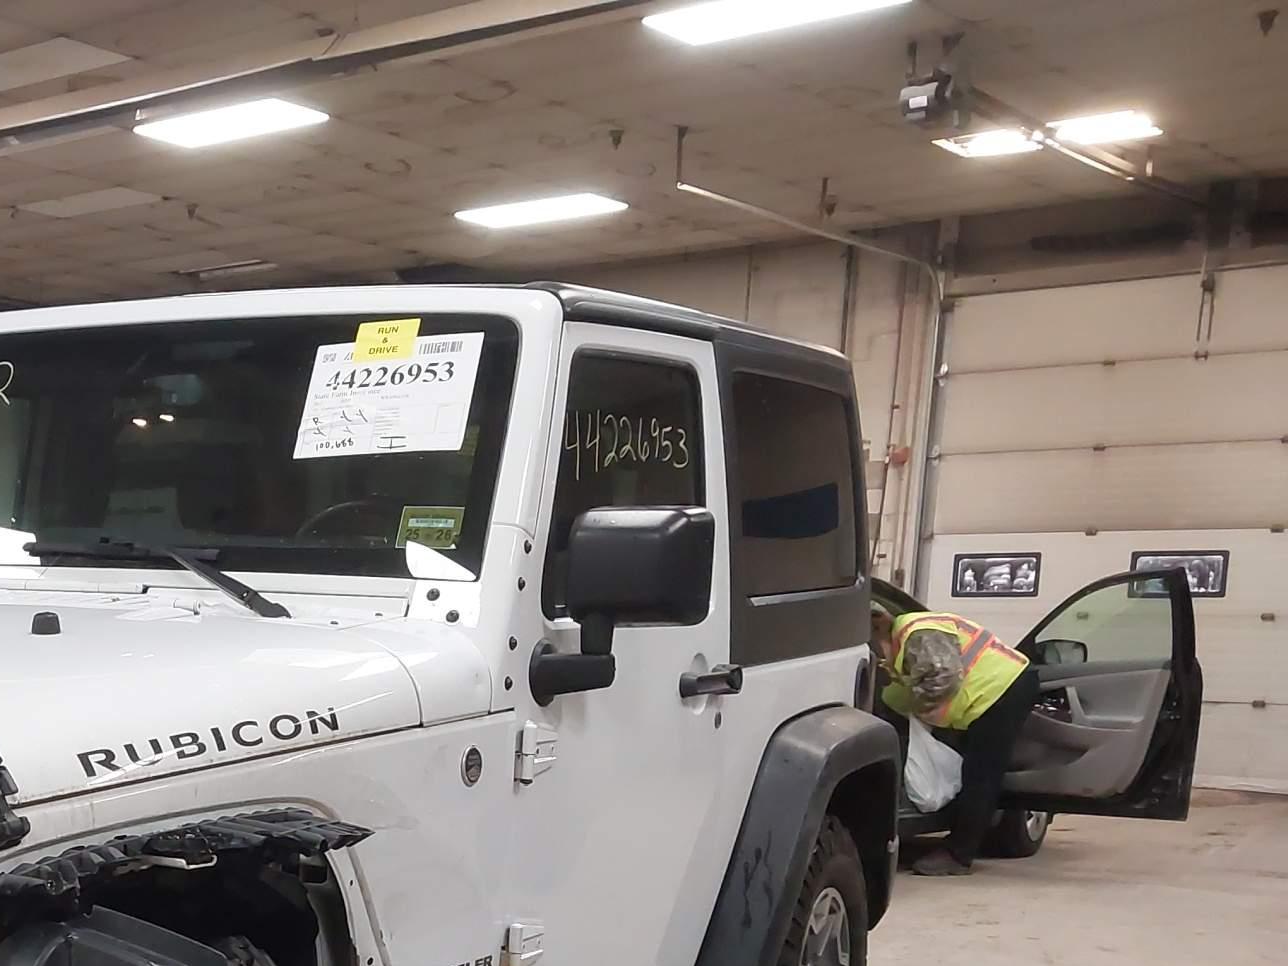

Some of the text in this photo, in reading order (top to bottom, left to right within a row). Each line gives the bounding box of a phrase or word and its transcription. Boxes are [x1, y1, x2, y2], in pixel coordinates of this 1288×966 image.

[378, 326, 399, 334] RUN
[369, 346, 399, 355] DRIVE
[326, 361, 455, 390] 44226953
[565, 409, 689, 480] 44226953
[76, 707, 340, 778] RUBICON
